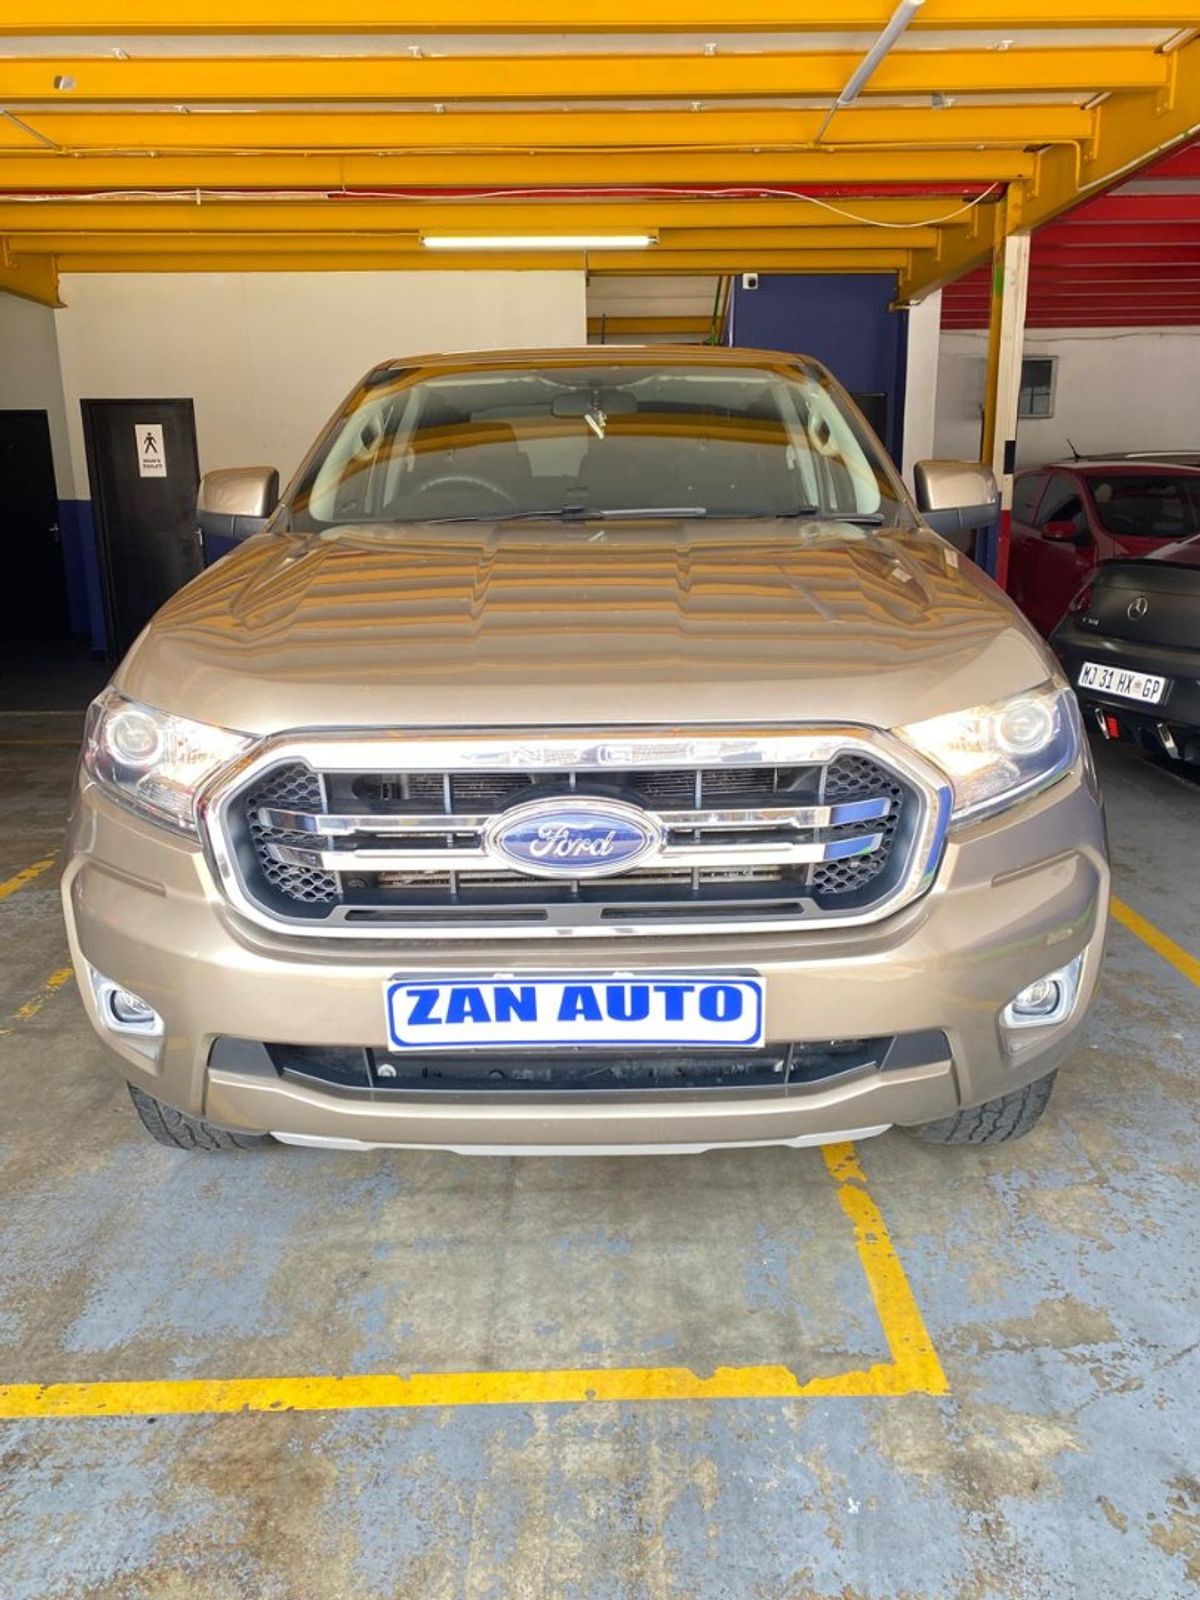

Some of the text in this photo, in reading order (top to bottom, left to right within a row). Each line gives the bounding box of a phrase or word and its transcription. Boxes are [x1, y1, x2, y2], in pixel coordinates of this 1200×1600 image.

[1081, 665, 1160, 699] MJ 31 HX GP
[529, 821, 616, 857] Ford
[405, 985, 743, 1026] ZAN AUTO
